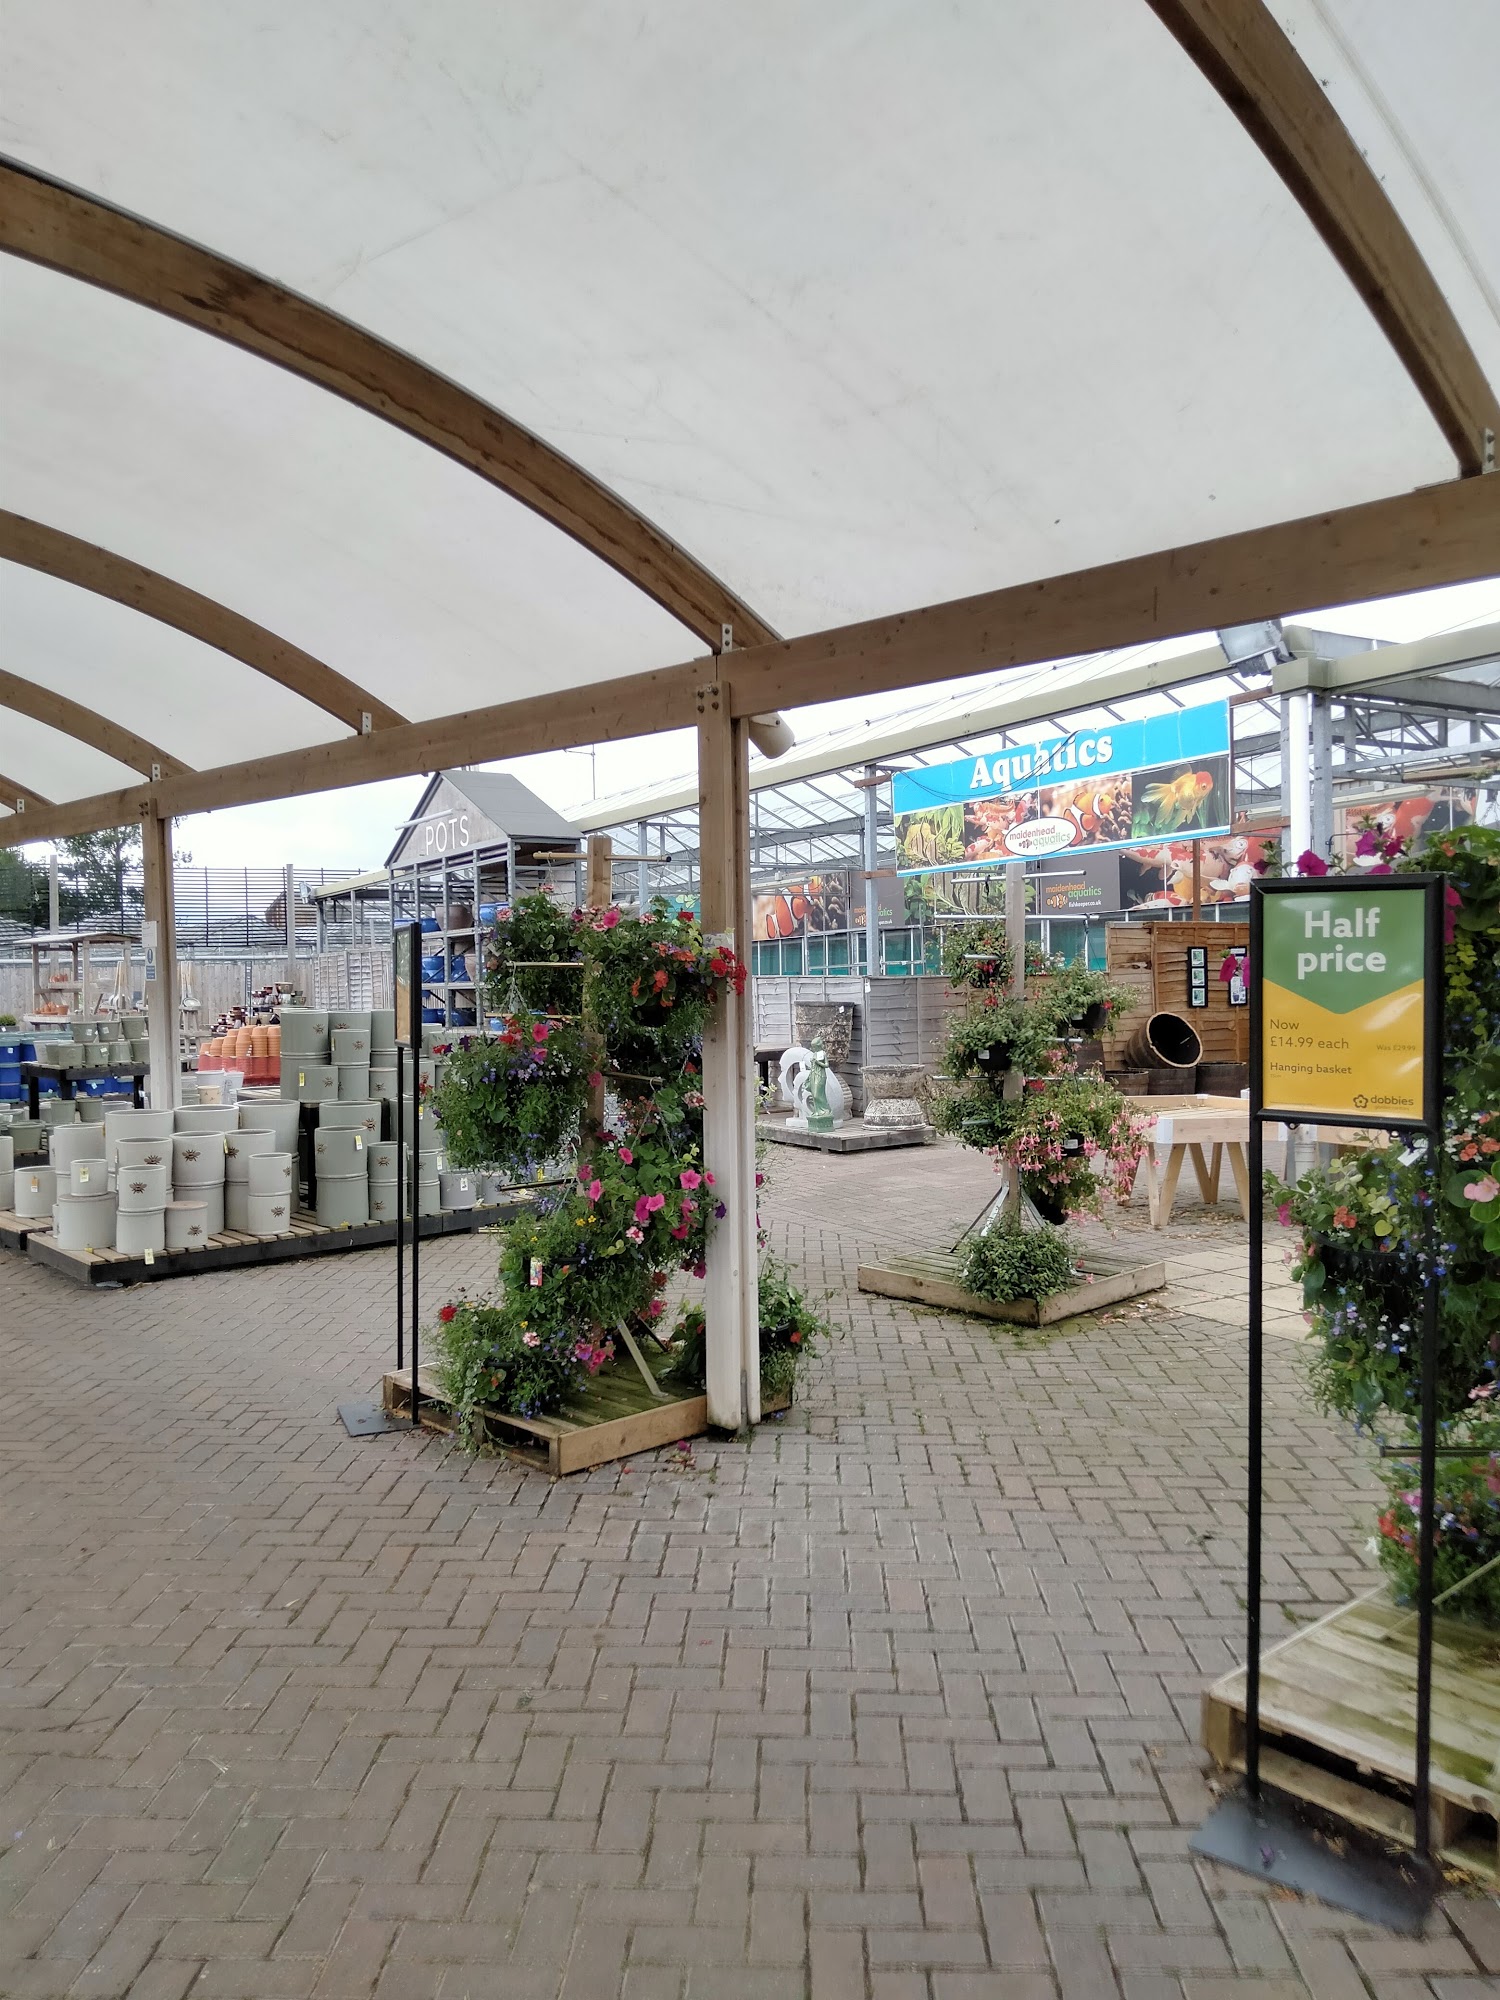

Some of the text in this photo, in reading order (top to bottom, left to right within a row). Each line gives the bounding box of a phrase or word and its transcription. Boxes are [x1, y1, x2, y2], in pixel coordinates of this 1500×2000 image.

[970, 733, 1113, 791] Aquatics
[425, 815, 470, 856] POTS
[1009, 825, 1056, 840] maidenhead
[1033, 832, 1071, 847] aquatics
[1045, 881, 1086, 893] maidenhead
[1068, 886, 1102, 900] aquatics
[1304, 907, 1381, 939] Half
[1297, 944, 1387, 980] price
[1270, 1019, 1300, 1030] Now
[1270, 1036, 1349, 1050] £14.99 each
[1270, 1062, 1352, 1075] Hanging basket
[1370, 1094, 1414, 1106] dobbies
